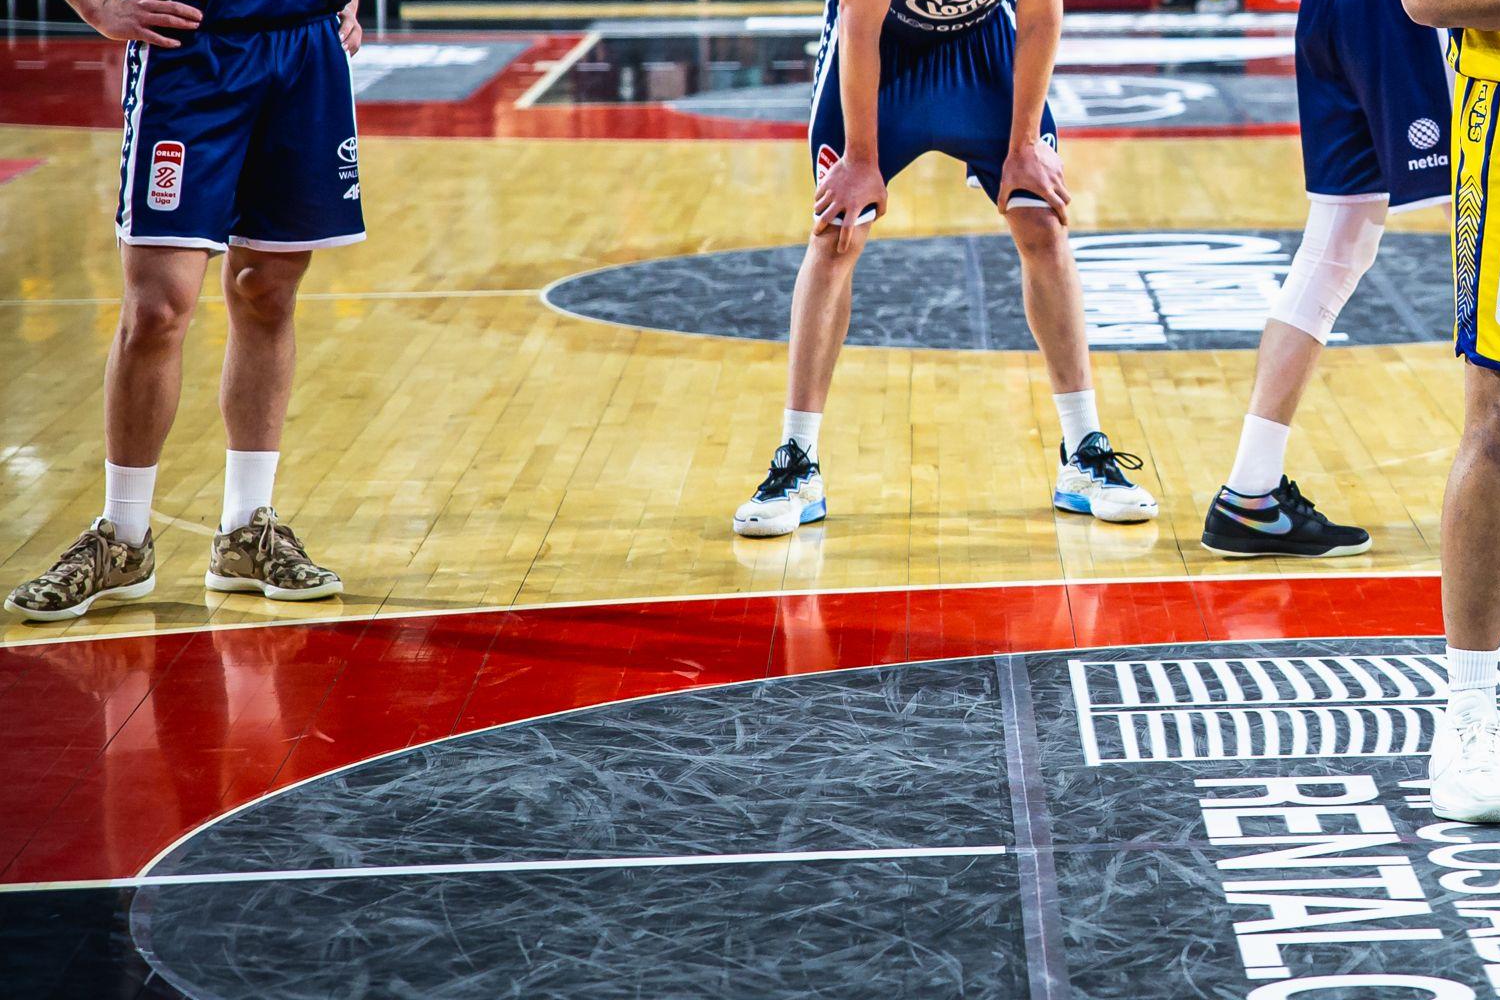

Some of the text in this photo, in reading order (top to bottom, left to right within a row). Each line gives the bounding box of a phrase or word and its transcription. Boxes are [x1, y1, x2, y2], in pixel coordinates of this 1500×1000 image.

[1467, 84, 1488, 143] STAL
[155, 149, 181, 158] ORLEN
[1408, 153, 1449, 171] netia
[151, 190, 176, 199] Basket
[155, 197, 171, 205] Liga
